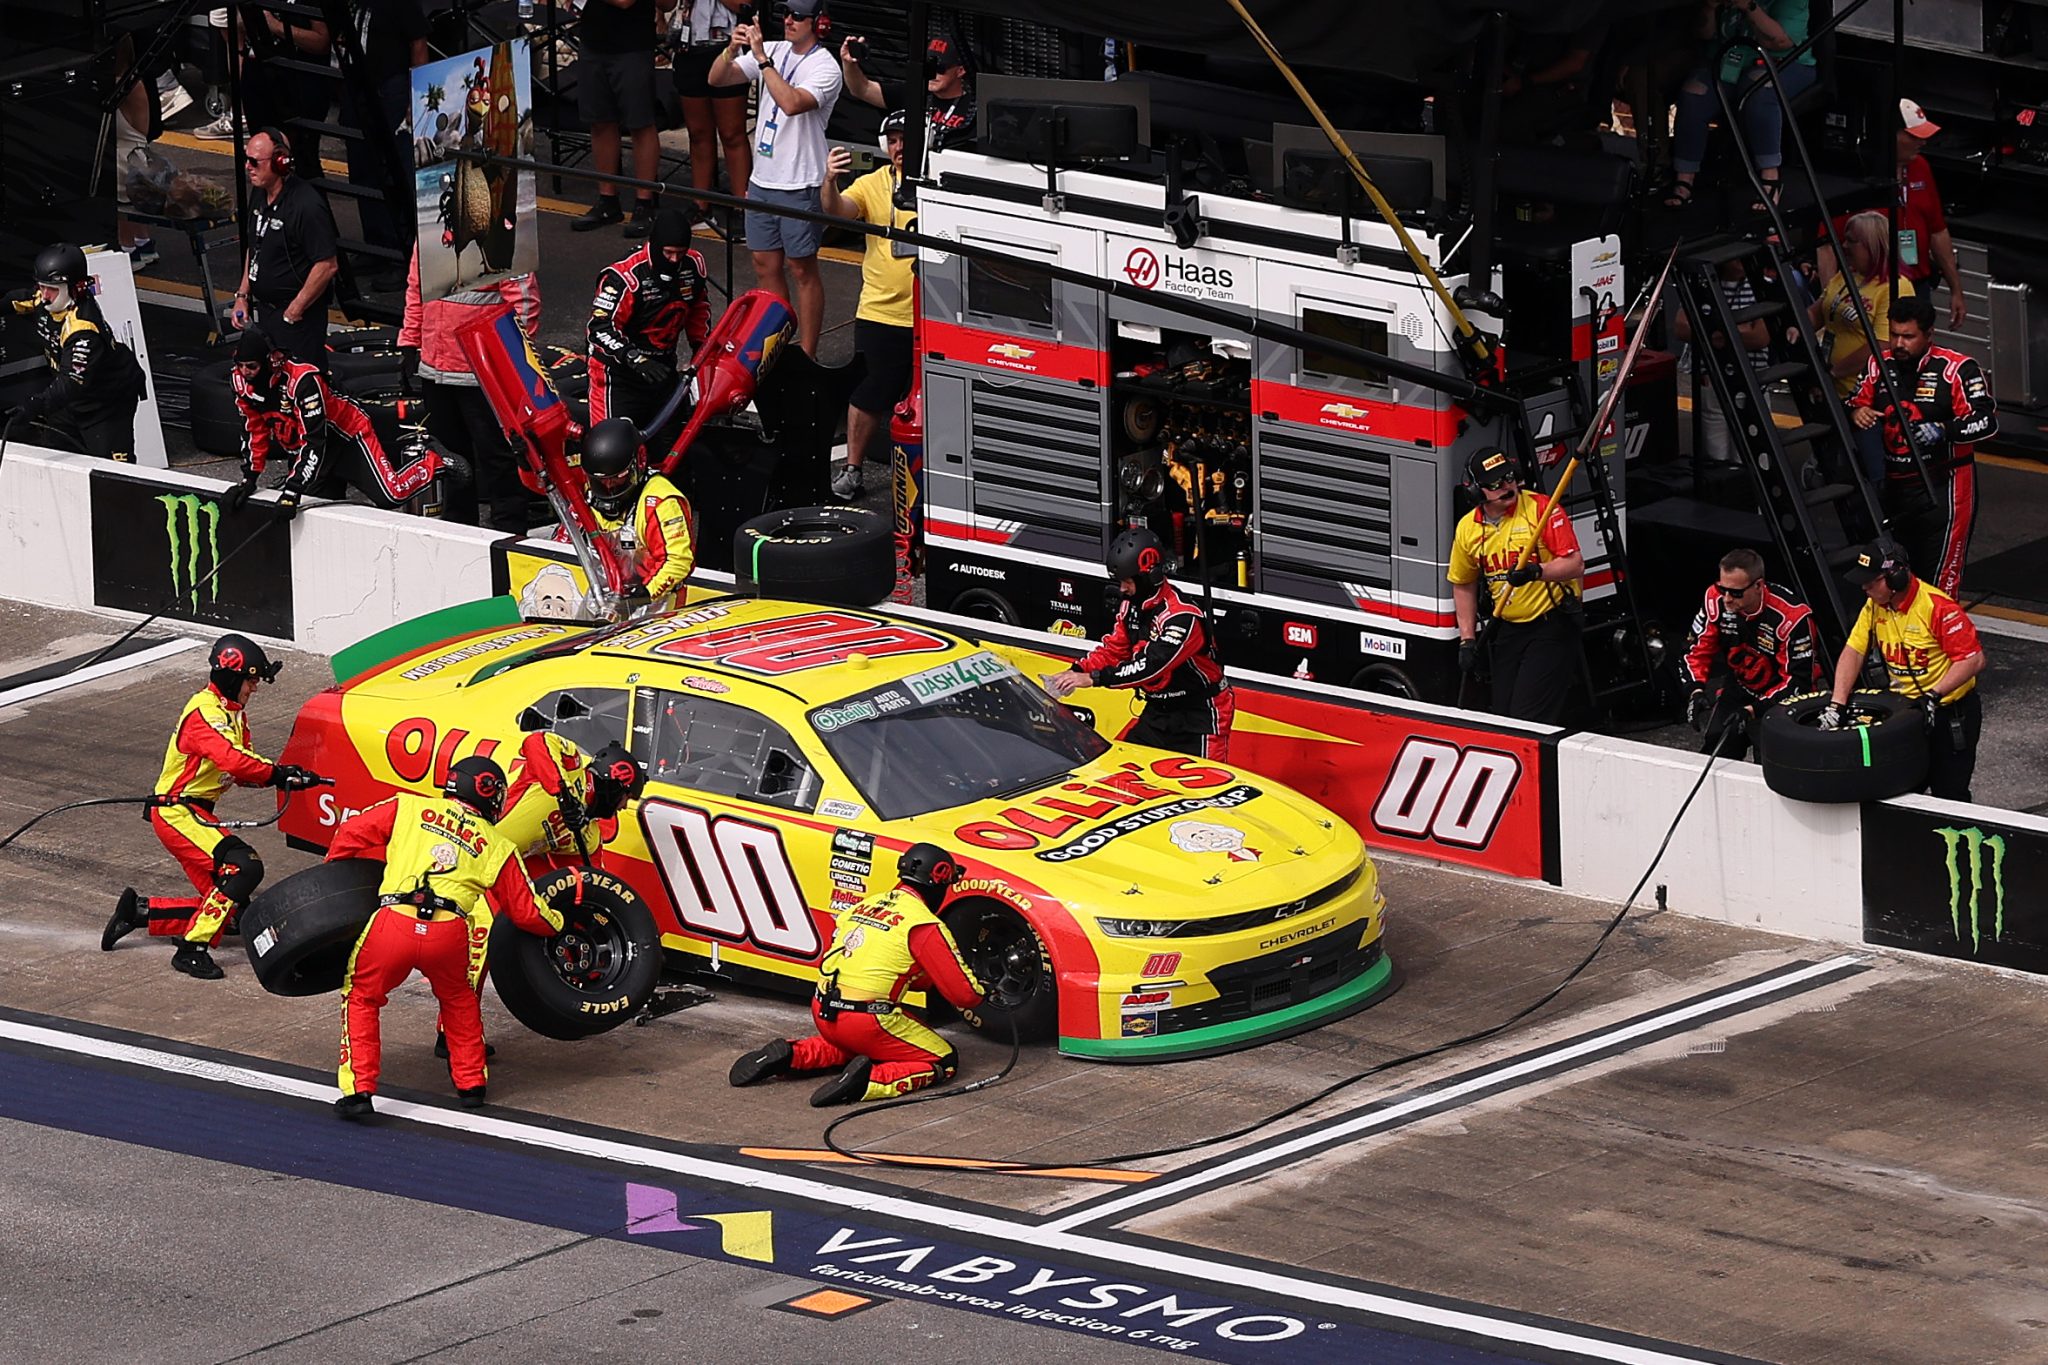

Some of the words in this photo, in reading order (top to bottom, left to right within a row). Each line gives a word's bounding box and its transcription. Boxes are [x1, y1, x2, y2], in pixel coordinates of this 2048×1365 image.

[1165, 255, 1233, 288] Haas
[1165, 281, 1203, 299] Factory
[1206, 285, 1234, 301] Team
[595, 331, 625, 351] HAAS
[988, 357, 1037, 371] CHEVROLET
[1320, 416, 1370, 431] CHEVROLET
[1961, 416, 1989, 435] HAAS
[301, 450, 319, 485] HAAS
[960, 564, 1006, 580] AUTODESK
[1050, 600, 1069, 609] TEXAS
[1049, 619, 1087, 639] Andy's
[1288, 626, 1313, 644] SEM
[653, 610, 958, 676] 00
[1364, 637, 1391, 653] Mobil
[911, 672, 958, 698] DASH
[954, 656, 982, 689] 4
[976, 657, 1008, 678] CAS
[1115, 658, 1147, 677] HAAS
[875, 690, 900, 704] AUTO
[878, 697, 911, 713] PARTS
[813, 700, 879, 732] O'Reilly
[1372, 737, 1521, 849] 00
[1116, 802, 1183, 830] STUFF
[640, 797, 821, 958] 00
[831, 872, 861, 885] LINCOLN
[953, 878, 1033, 912] GOODYEAR
[831, 900, 853, 912] MS
[1260, 916, 1337, 950] CHEVROLET
[1141, 952, 1182, 978] 00
[580, 995, 629, 1014] EAGLE
[1121, 991, 1170, 1005] ARP
[809, 1262, 1004, 1306] faricimab-svoa
[1007, 1302, 1124, 1335] injection
[1149, 1330, 1200, 1352] mg
